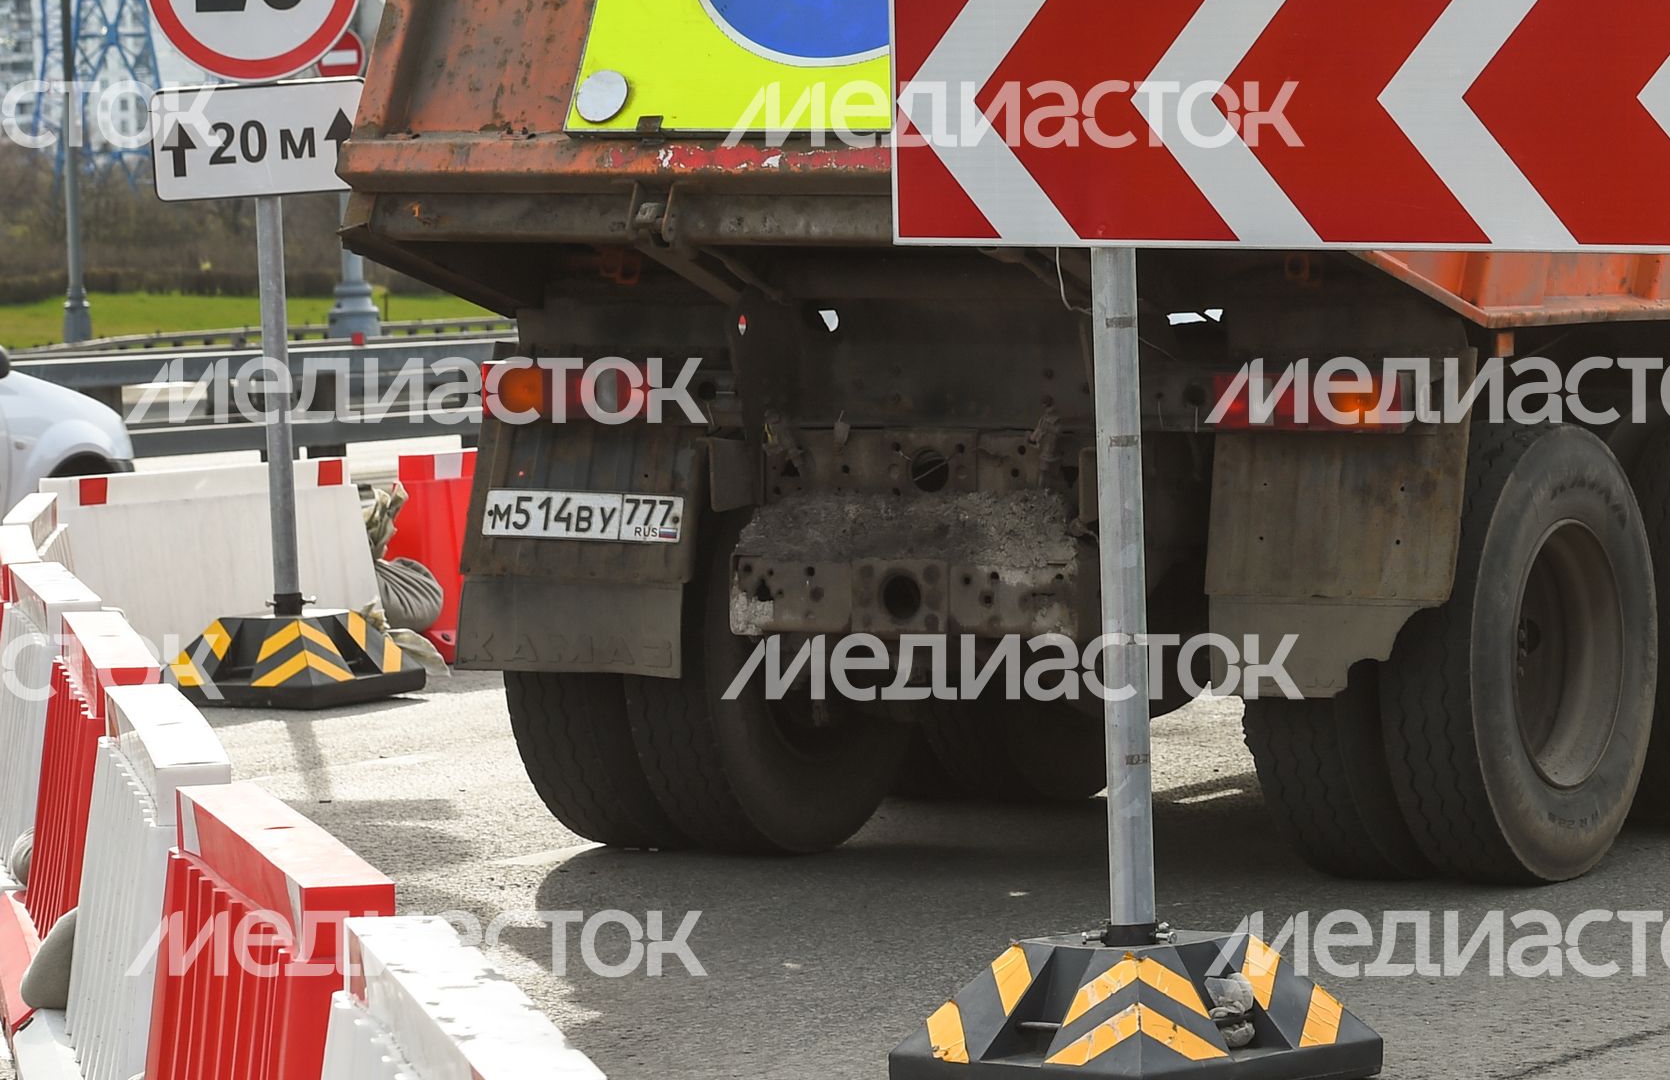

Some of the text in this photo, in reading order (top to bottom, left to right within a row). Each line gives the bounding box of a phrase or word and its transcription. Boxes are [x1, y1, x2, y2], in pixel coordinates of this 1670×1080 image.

[208, 119, 268, 166] 20
[624, 498, 675, 527] 777
[634, 527, 658, 538] RUS
